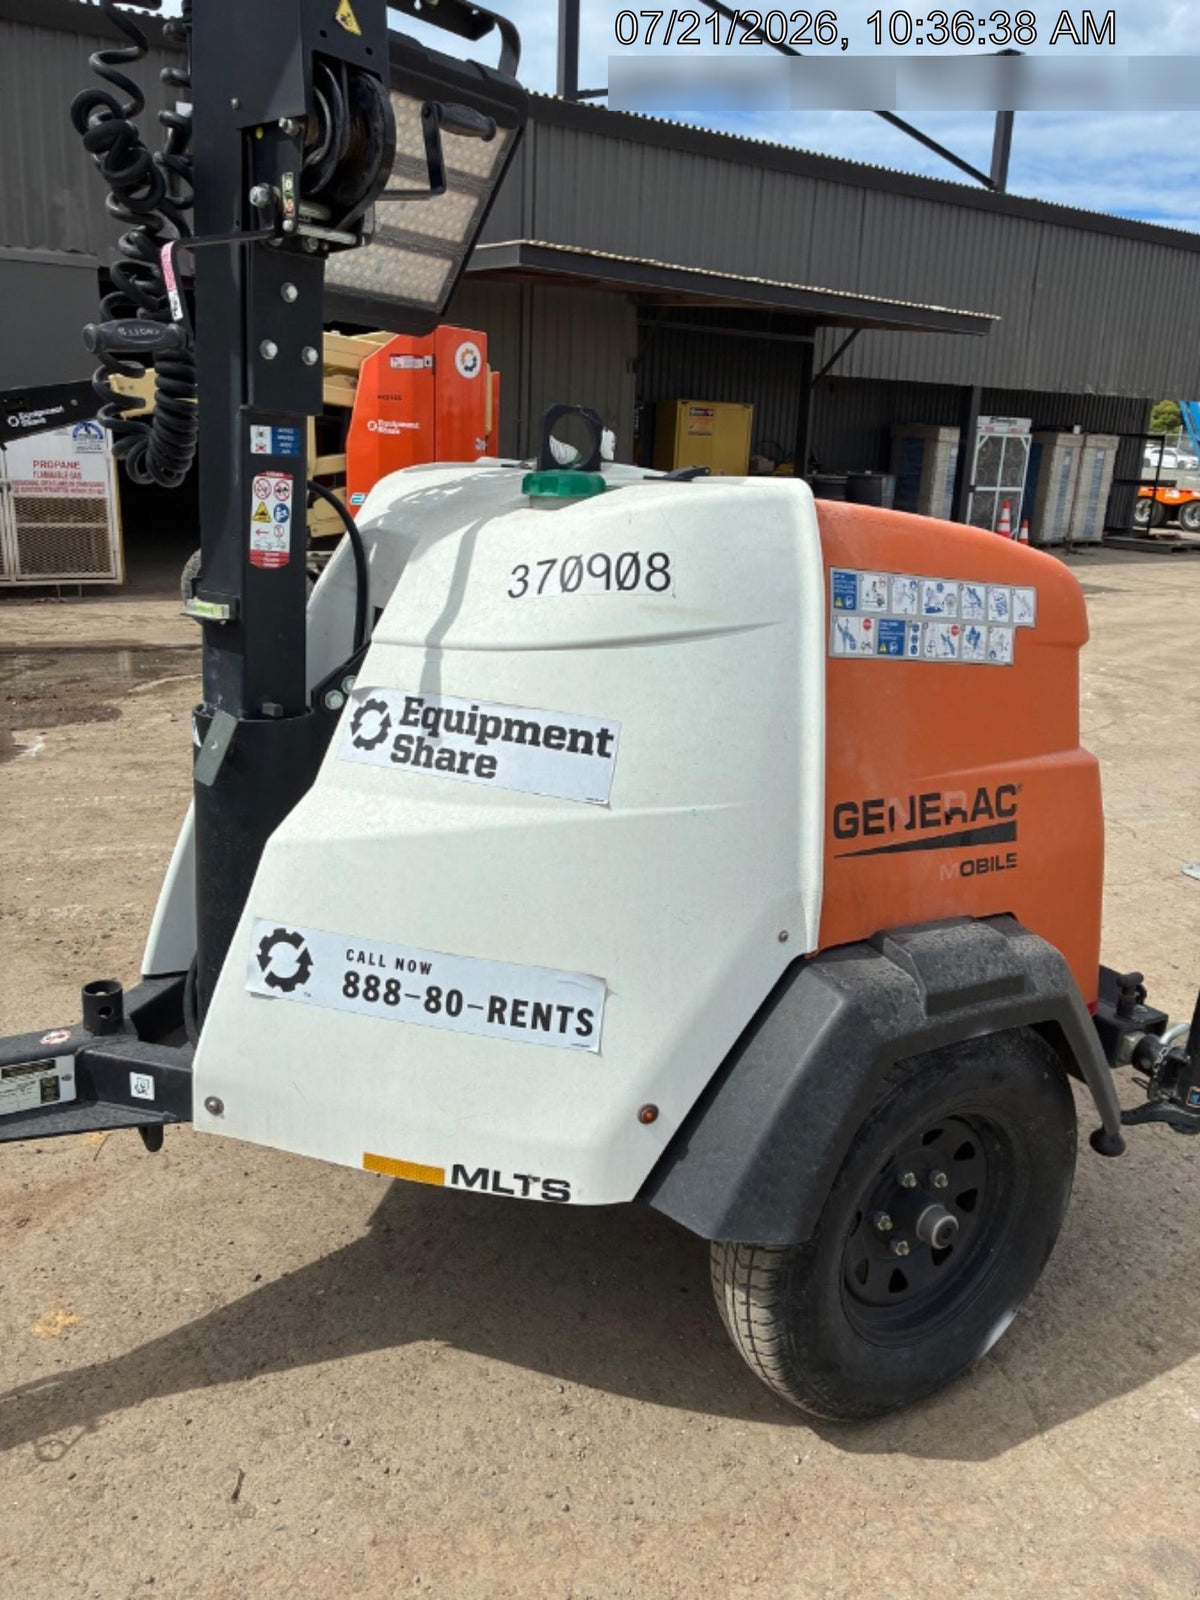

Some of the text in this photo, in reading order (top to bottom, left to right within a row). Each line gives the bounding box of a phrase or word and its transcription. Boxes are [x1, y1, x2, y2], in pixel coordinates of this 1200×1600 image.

[33, 460, 81, 470] PROPANE
[507, 551, 671, 599] 370908
[399, 696, 615, 758] Equipment
[390, 734, 498, 779] Share
[833, 783, 1017, 840] GENERAC
[345, 949, 433, 976] CALL NOW
[342, 970, 595, 1037] 888-80-RENTS
[451, 1163, 571, 1203] MLTS
